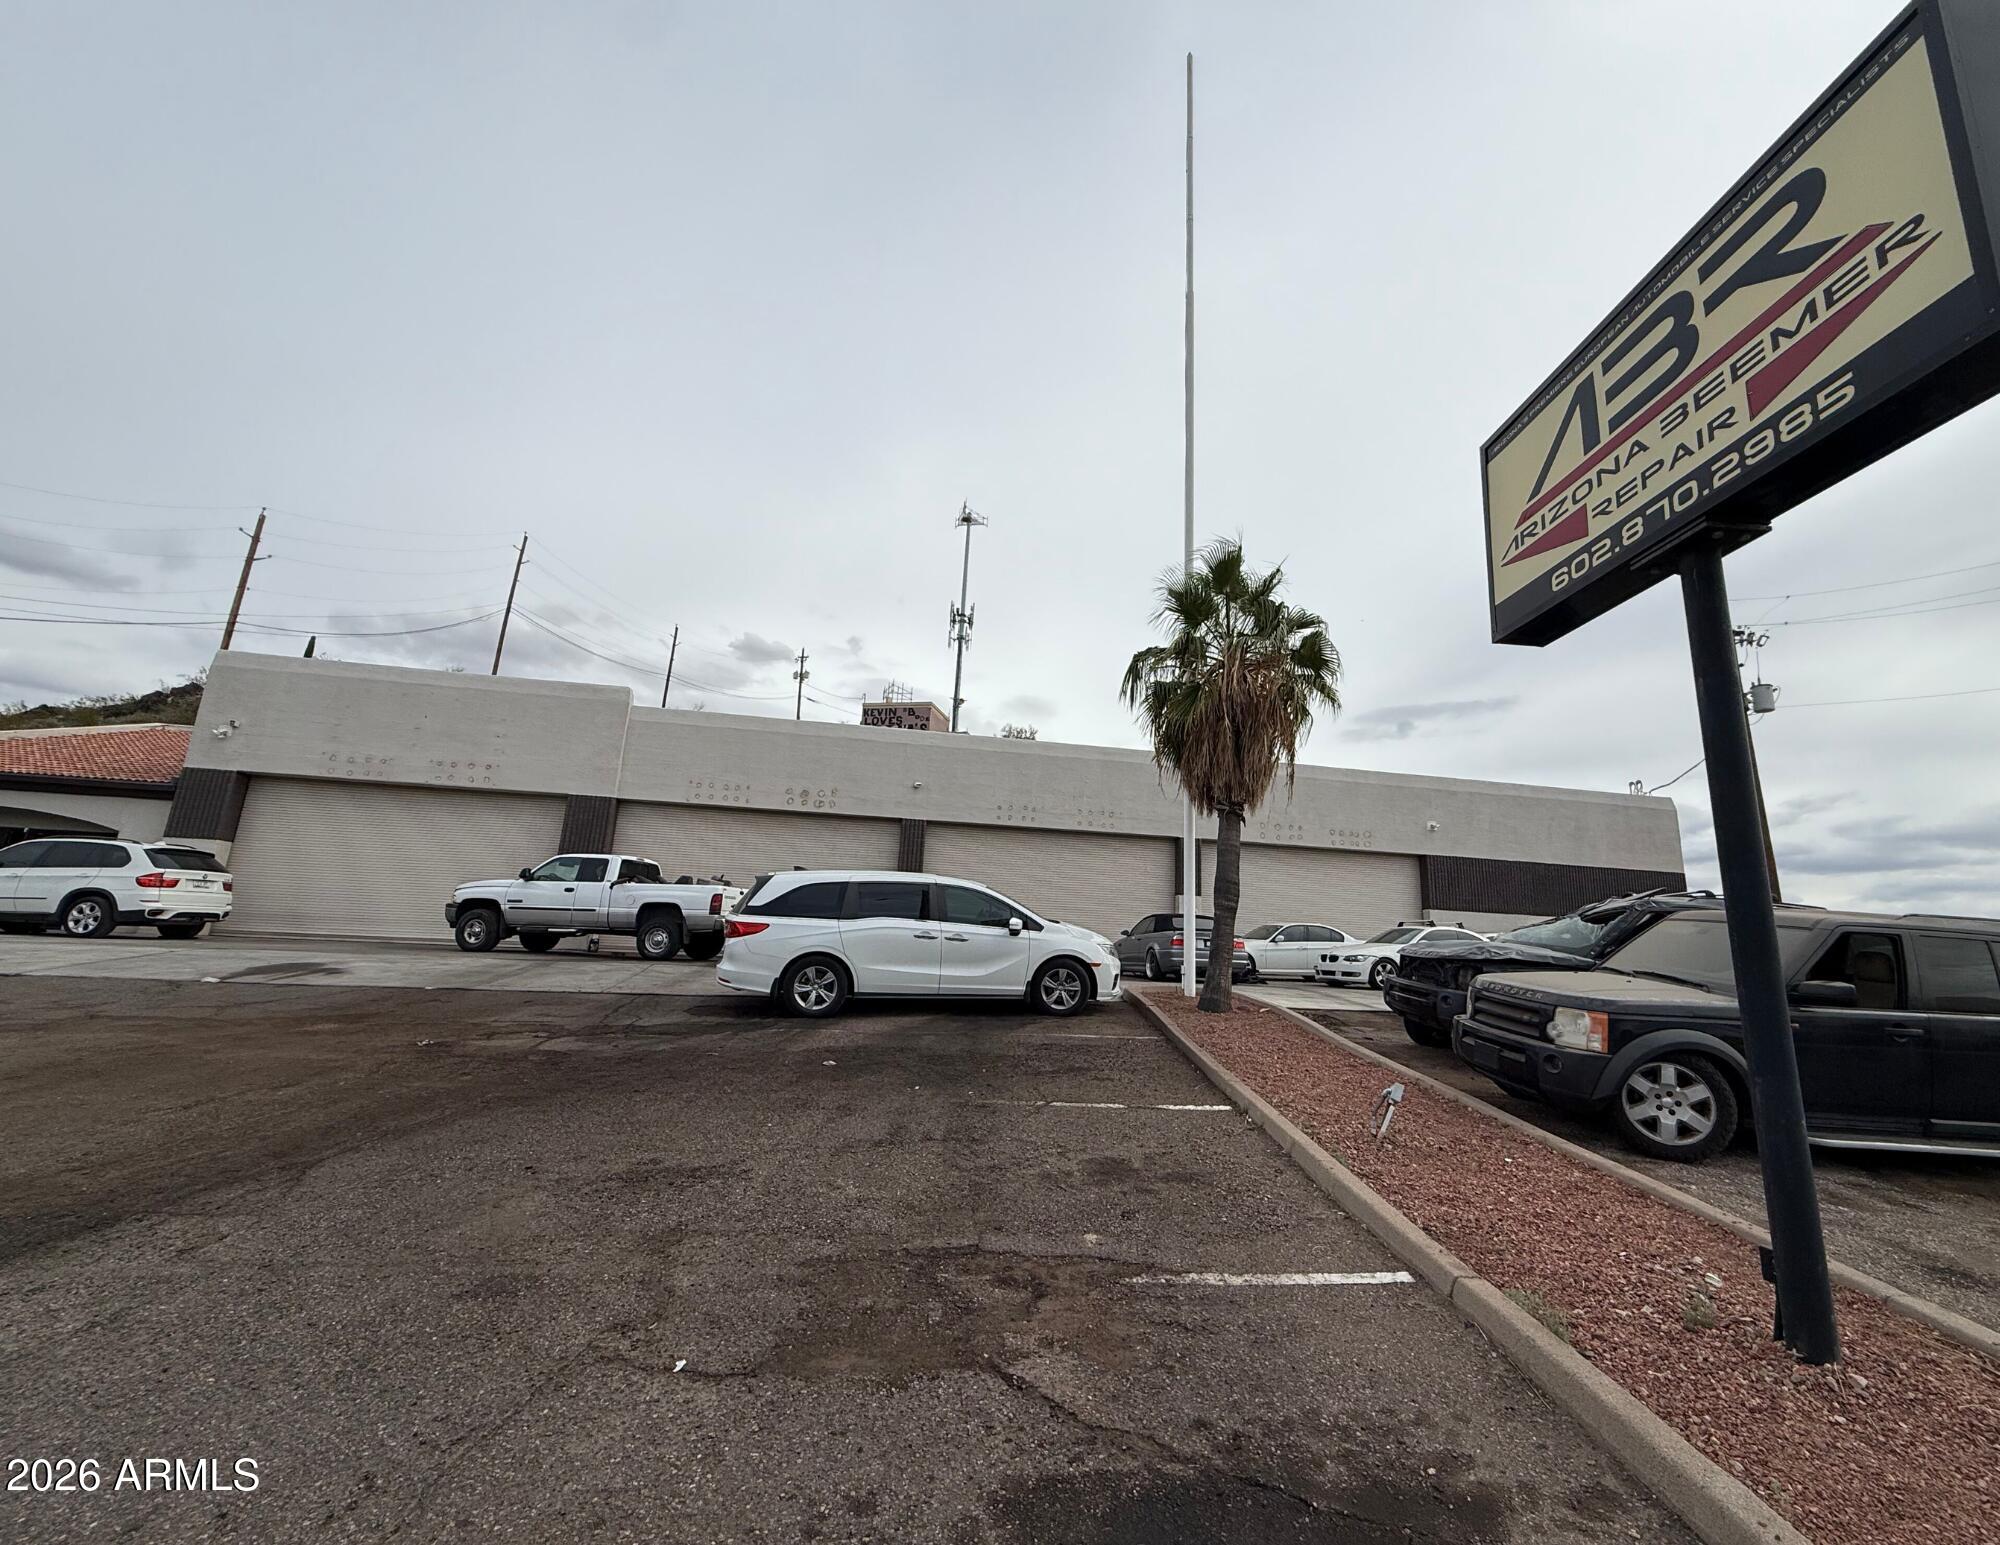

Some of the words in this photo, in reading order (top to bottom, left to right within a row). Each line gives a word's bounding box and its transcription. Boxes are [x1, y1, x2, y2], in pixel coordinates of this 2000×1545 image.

[1574, 315, 1630, 371] EUROPEAN
[1630, 233, 1710, 317] AUTOMOBILE
[1711, 165, 1779, 235] SERVICE
[1780, 32, 1911, 166] SPECIALISTS
[1500, 439, 1650, 562] ARIZONA
[1659, 213, 1931, 439] BEEMER
[1526, 167, 1848, 505] ABR
[1550, 369, 1857, 593] 602.870.2985
[1591, 406, 1740, 520] REPAIR
[863, 707, 897, 717] KEVIN
[864, 715, 903, 727] LOVES
